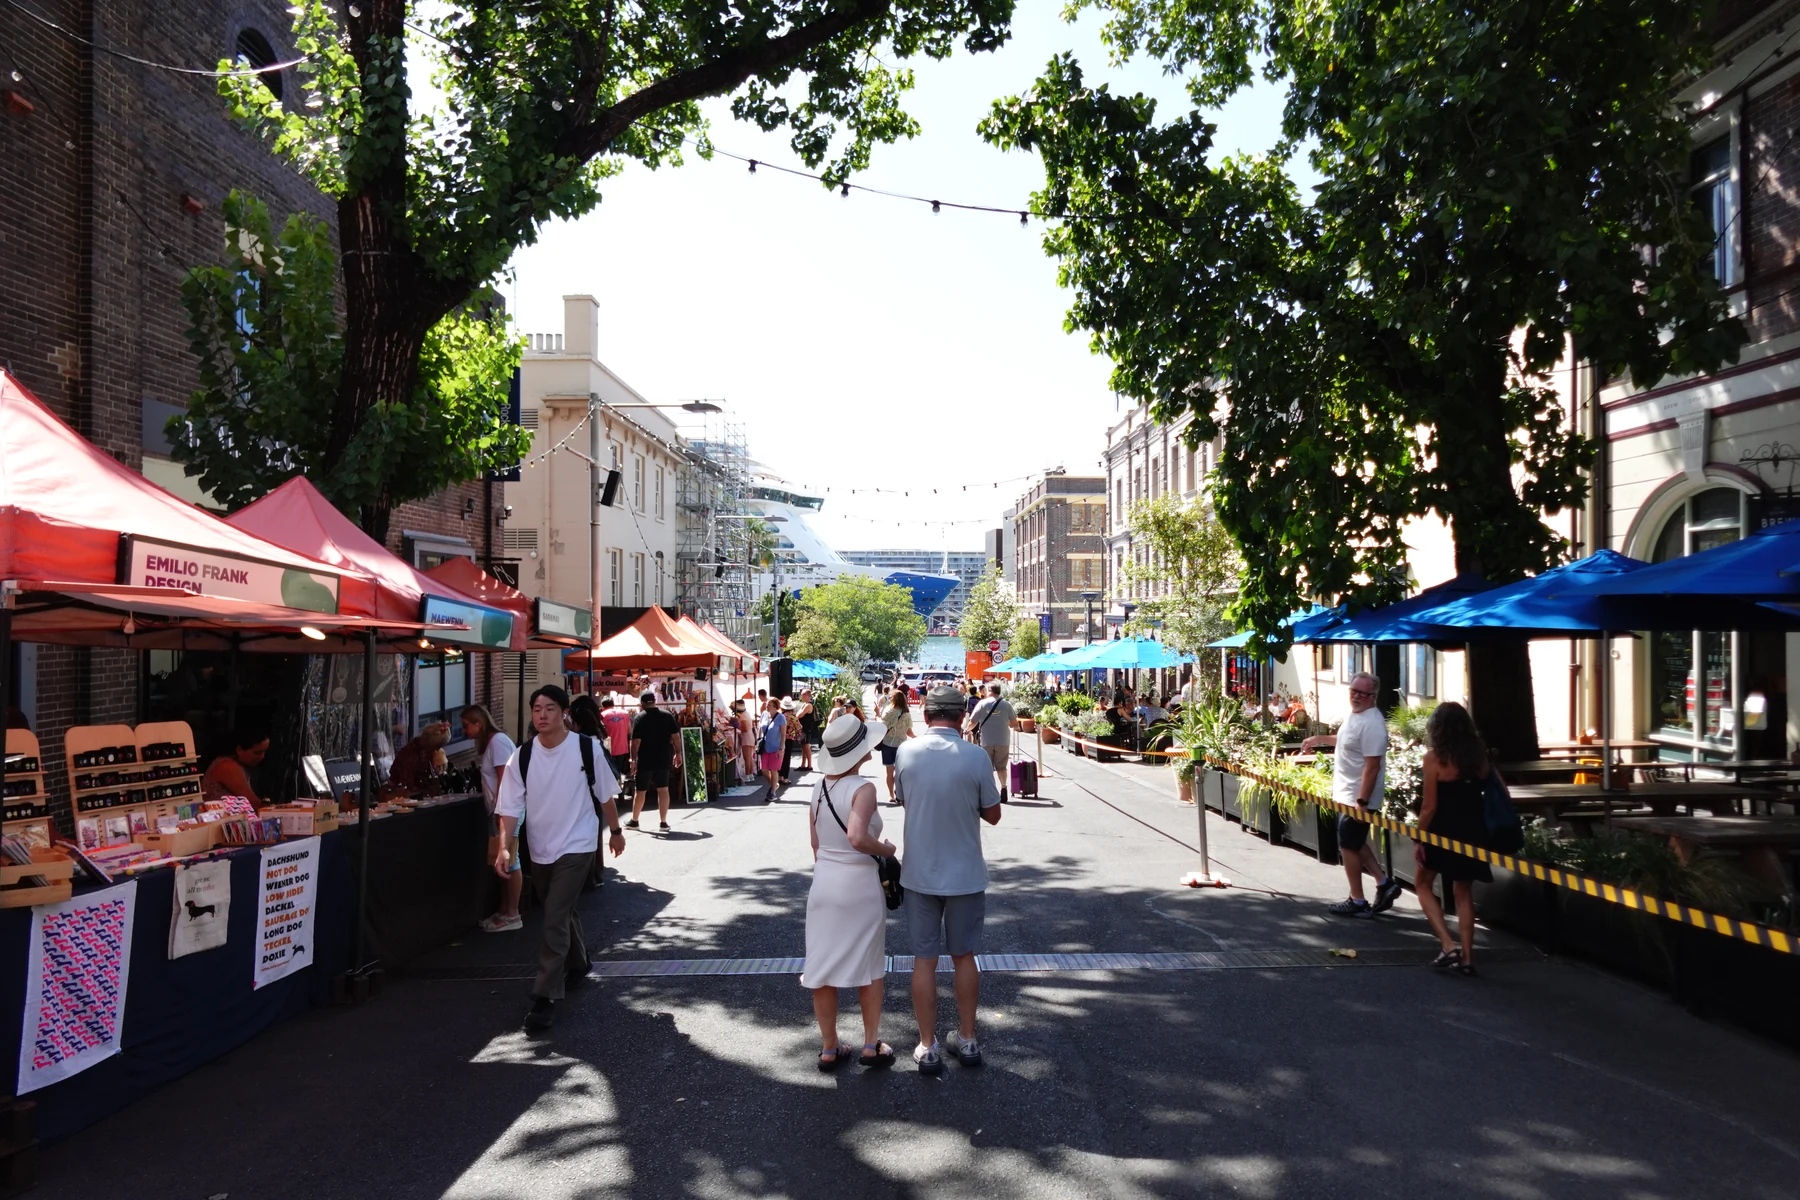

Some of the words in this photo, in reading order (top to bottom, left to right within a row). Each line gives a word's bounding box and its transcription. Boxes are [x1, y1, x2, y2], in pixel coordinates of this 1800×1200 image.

[146, 554, 199, 577] EMILIO
[202, 564, 249, 585] FRANK
[145, 574, 203, 594] DESIGN
[267, 850, 309, 867] DACHSHUND
[266, 869, 282, 880] HOT
[283, 865, 298, 875] DOG
[266, 877, 294, 891] WIENER
[295, 872, 310, 883] DOG
[265, 891, 285, 904] LOW
[265, 901, 295, 916] DACKEL
[264, 910, 298, 928] SAUSAGE
[264, 926, 284, 940] LONG
[286, 920, 303, 933] DOG
[264, 936, 292, 952] TECKEL
[262, 949, 286, 964] DOXIE
